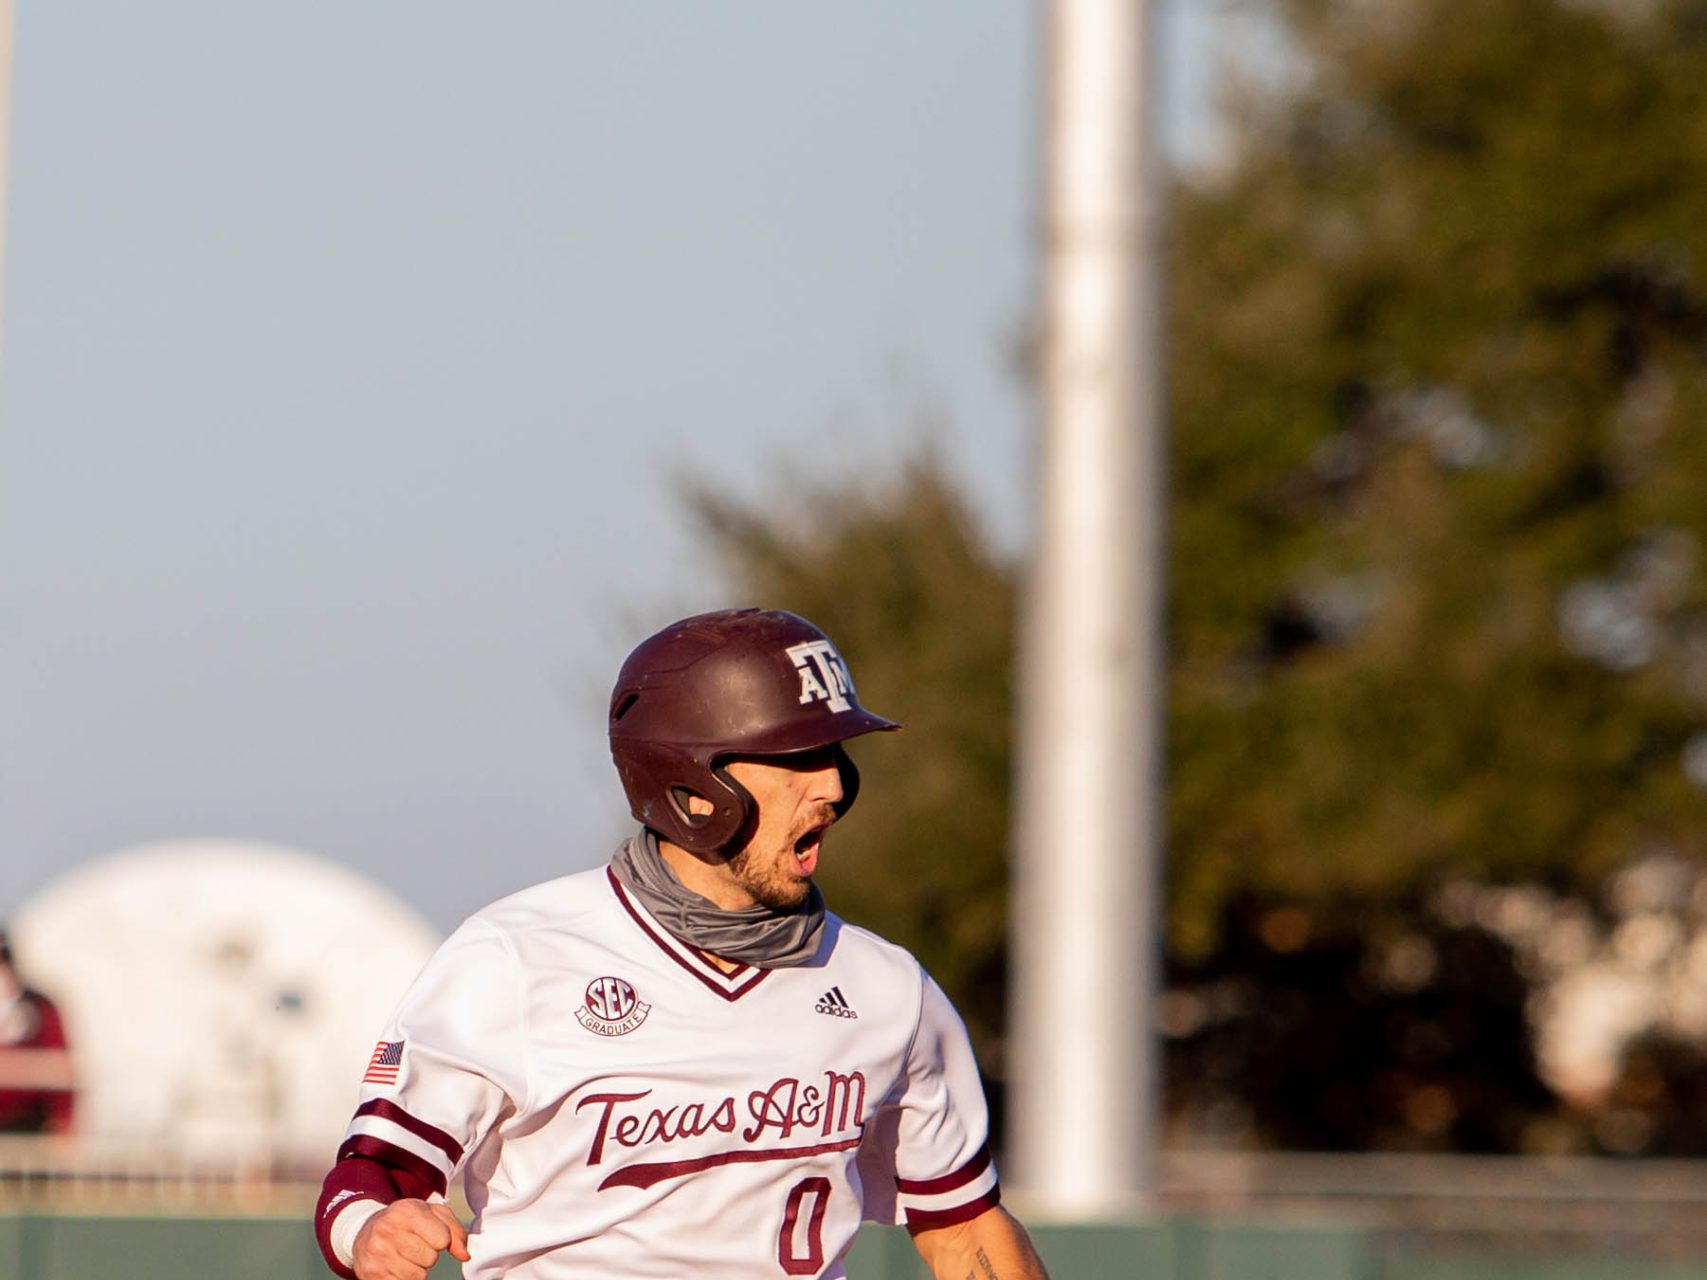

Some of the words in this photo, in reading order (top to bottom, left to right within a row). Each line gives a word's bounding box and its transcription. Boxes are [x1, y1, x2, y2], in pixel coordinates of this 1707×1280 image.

[587, 978, 635, 1020] SEC
[815, 1004, 858, 1019] adidas
[585, 1014, 643, 1035] GRADUATE
[575, 1089, 735, 1166] Texas
[743, 1071, 864, 1143] A&M
[778, 1177, 832, 1276] 0
